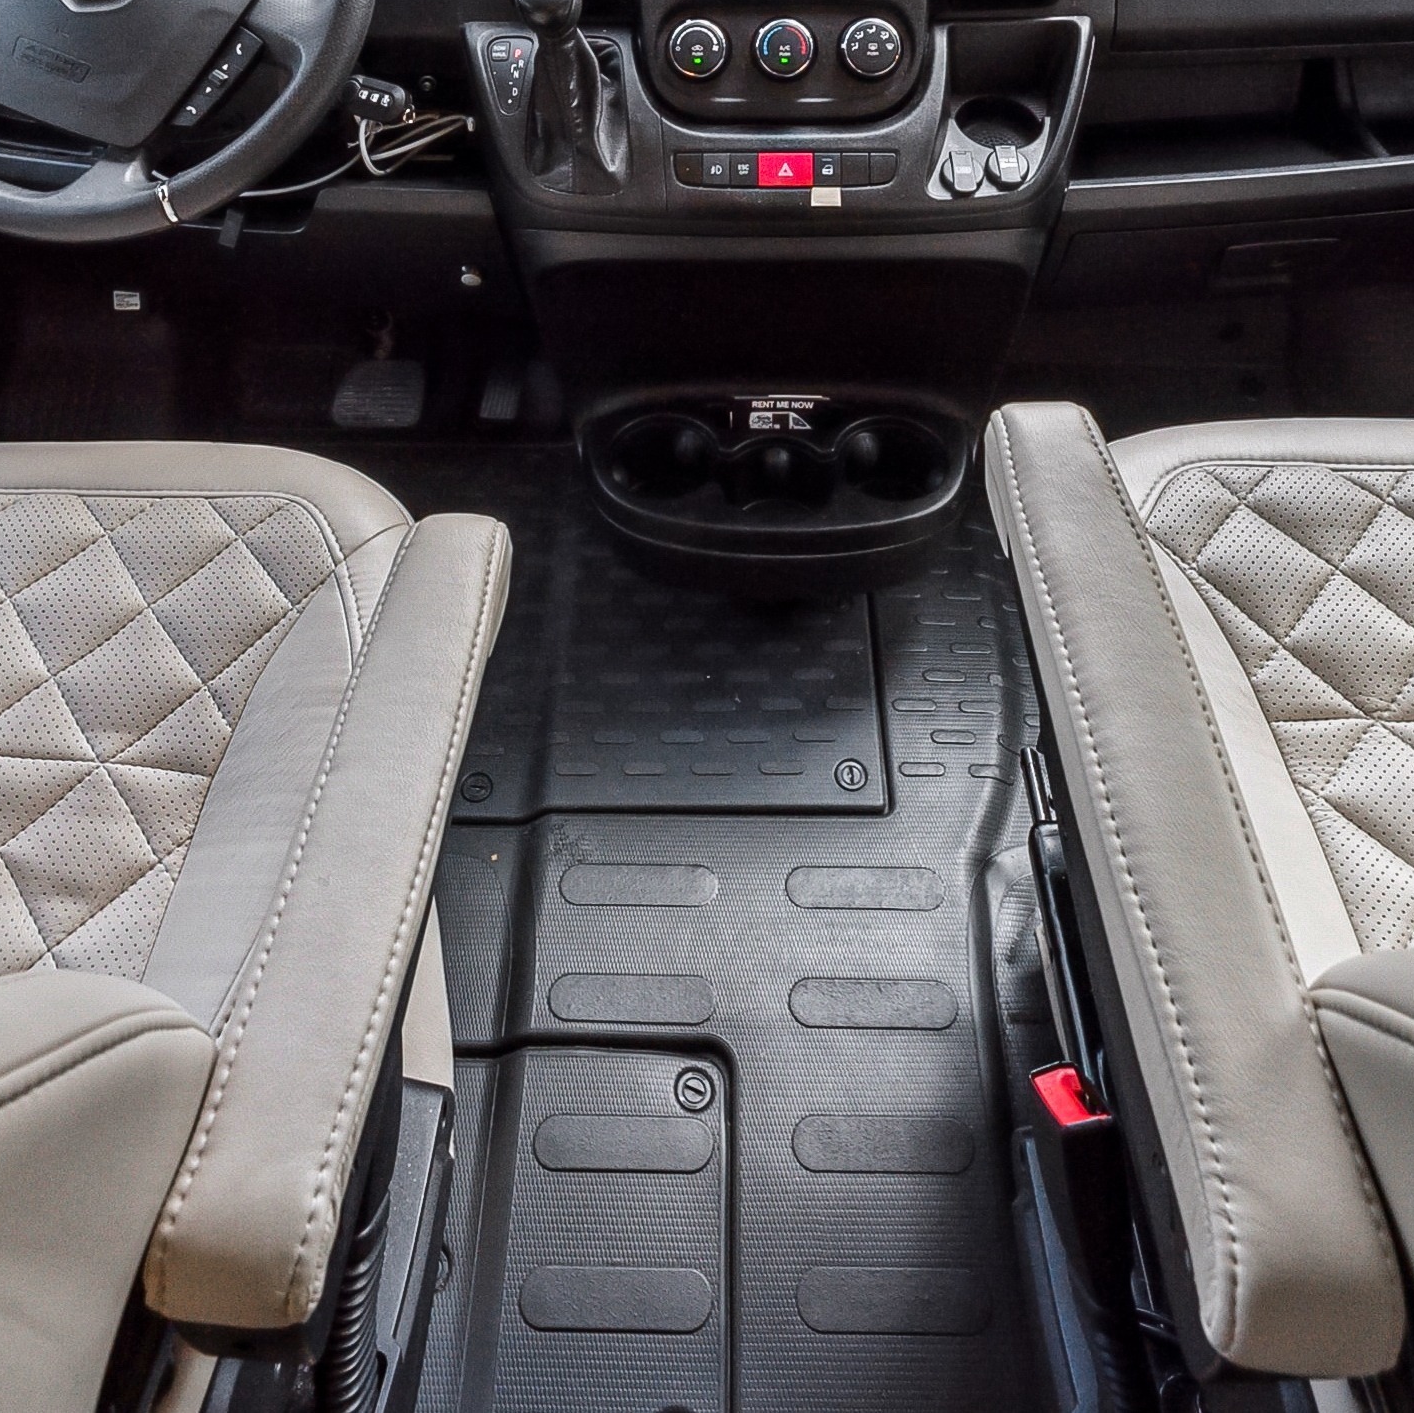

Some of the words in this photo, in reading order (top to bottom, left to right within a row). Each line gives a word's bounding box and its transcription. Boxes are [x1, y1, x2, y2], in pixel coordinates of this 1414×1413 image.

[514, 48, 522, 58] P
[518, 59, 525, 68] R
[513, 70, 520, 79] N
[512, 87, 518, 97] D
[751, 400, 775, 408] RENT
[776, 400, 790, 409] ME
[791, 401, 815, 410] NOW
